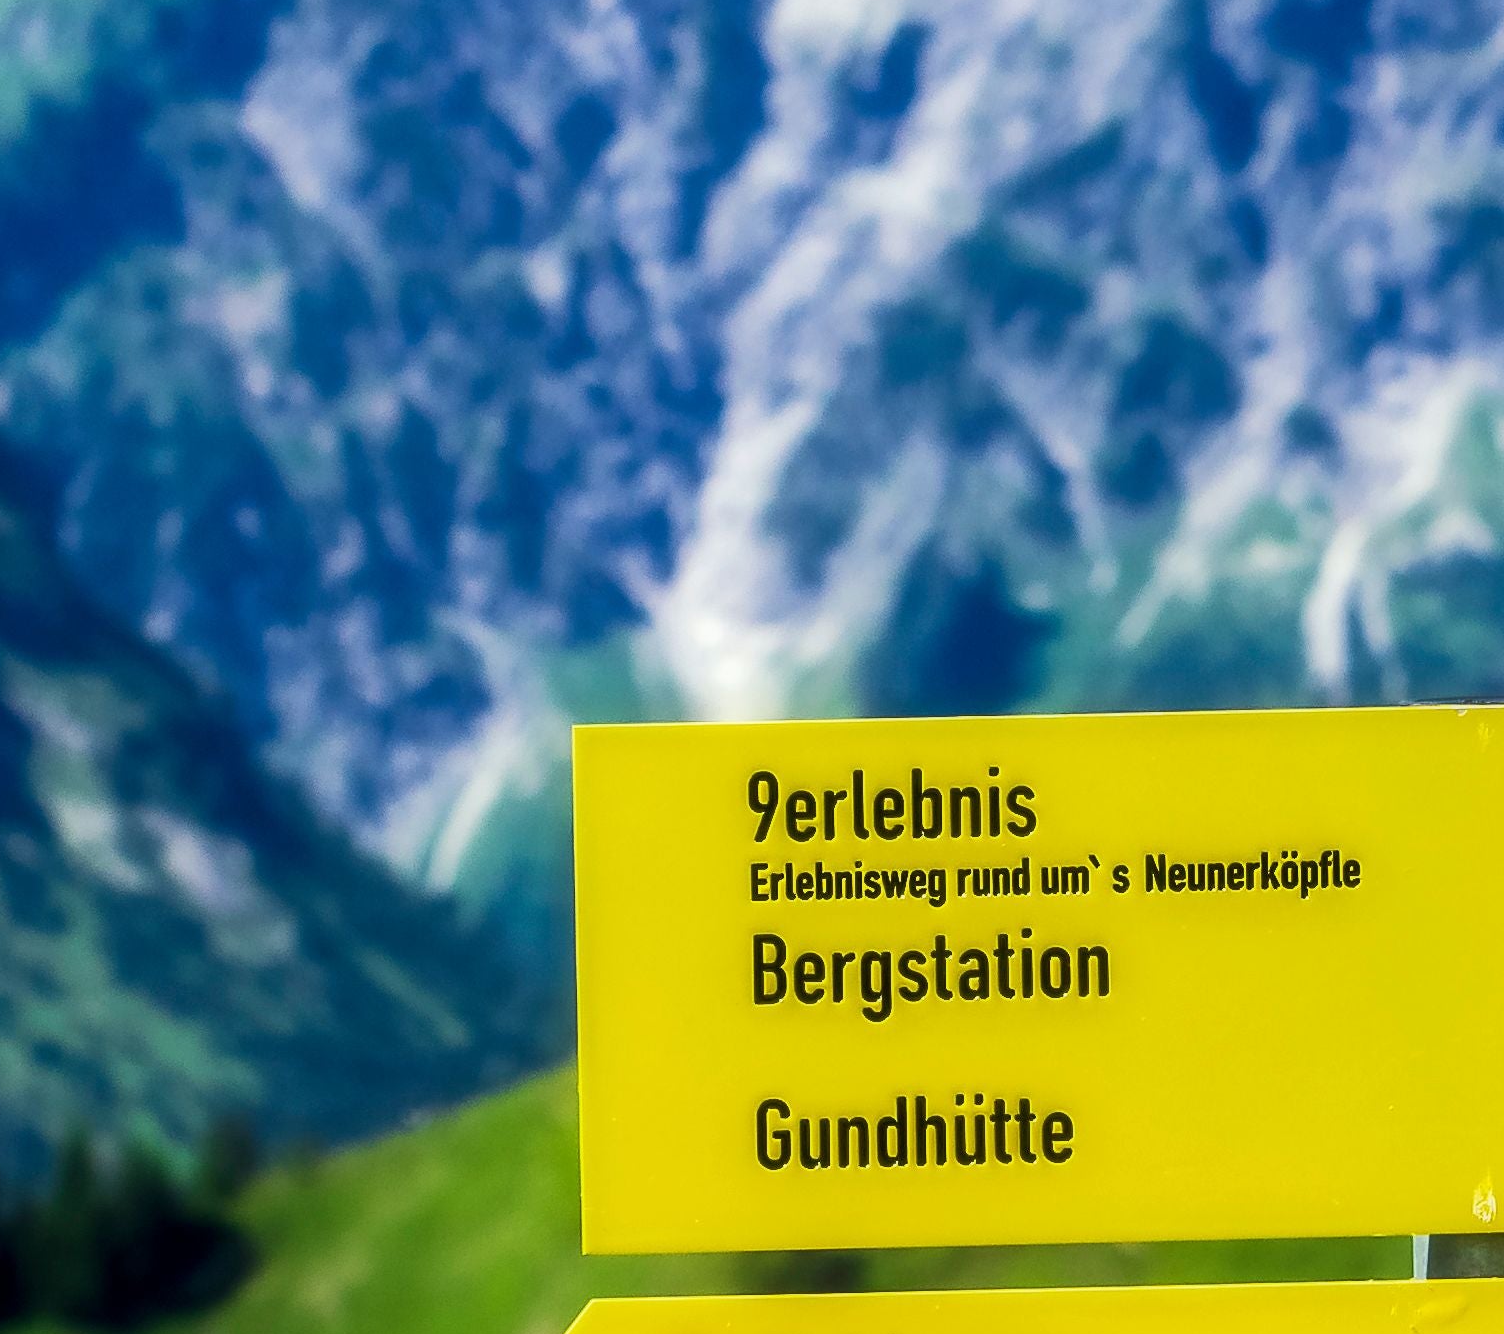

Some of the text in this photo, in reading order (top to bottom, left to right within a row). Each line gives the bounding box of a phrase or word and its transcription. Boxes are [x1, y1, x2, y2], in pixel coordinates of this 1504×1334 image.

[748, 766, 1037, 843] 9erlebnis
[750, 860, 947, 908] Erlebnisweg
[956, 856, 1031, 897] rund
[1145, 849, 1361, 900] Neunerköpfle
[752, 927, 1110, 1023] Bergstation
[756, 1093, 1074, 1171] Gundhütte
